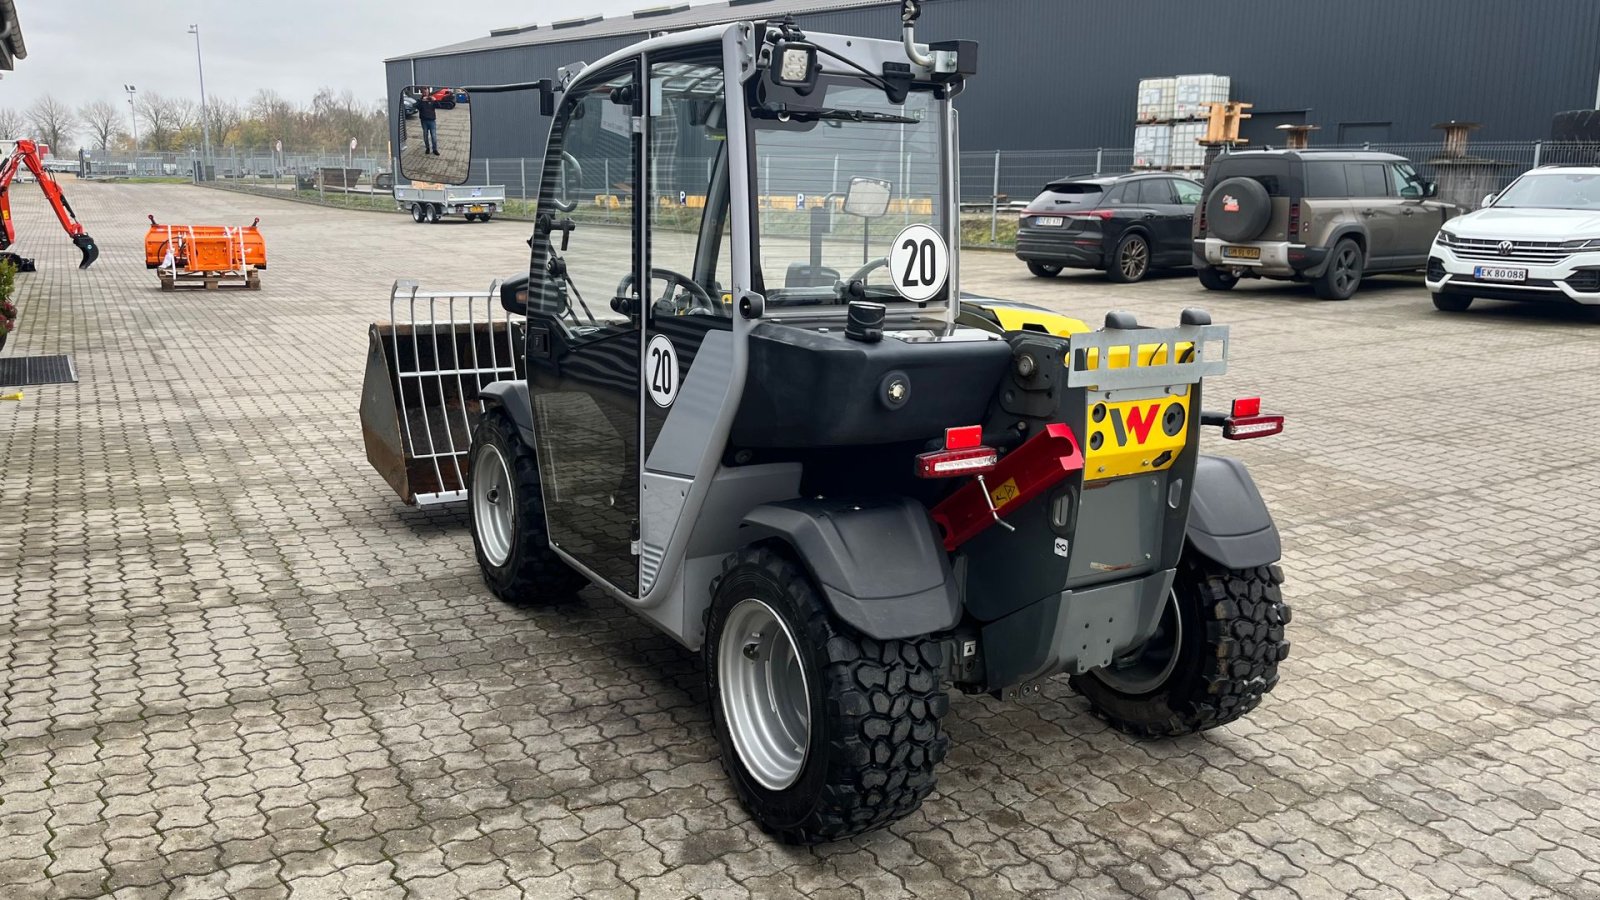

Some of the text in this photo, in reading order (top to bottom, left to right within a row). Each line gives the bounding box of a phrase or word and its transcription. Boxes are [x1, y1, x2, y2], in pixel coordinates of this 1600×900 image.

[679, 190, 686, 202] P
[797, 193, 804, 205] P
[902, 238, 936, 287] 20
[1481, 269, 1524, 279] EK 80 088
[652, 347, 671, 395] 20
[1109, 403, 1161, 447] W
